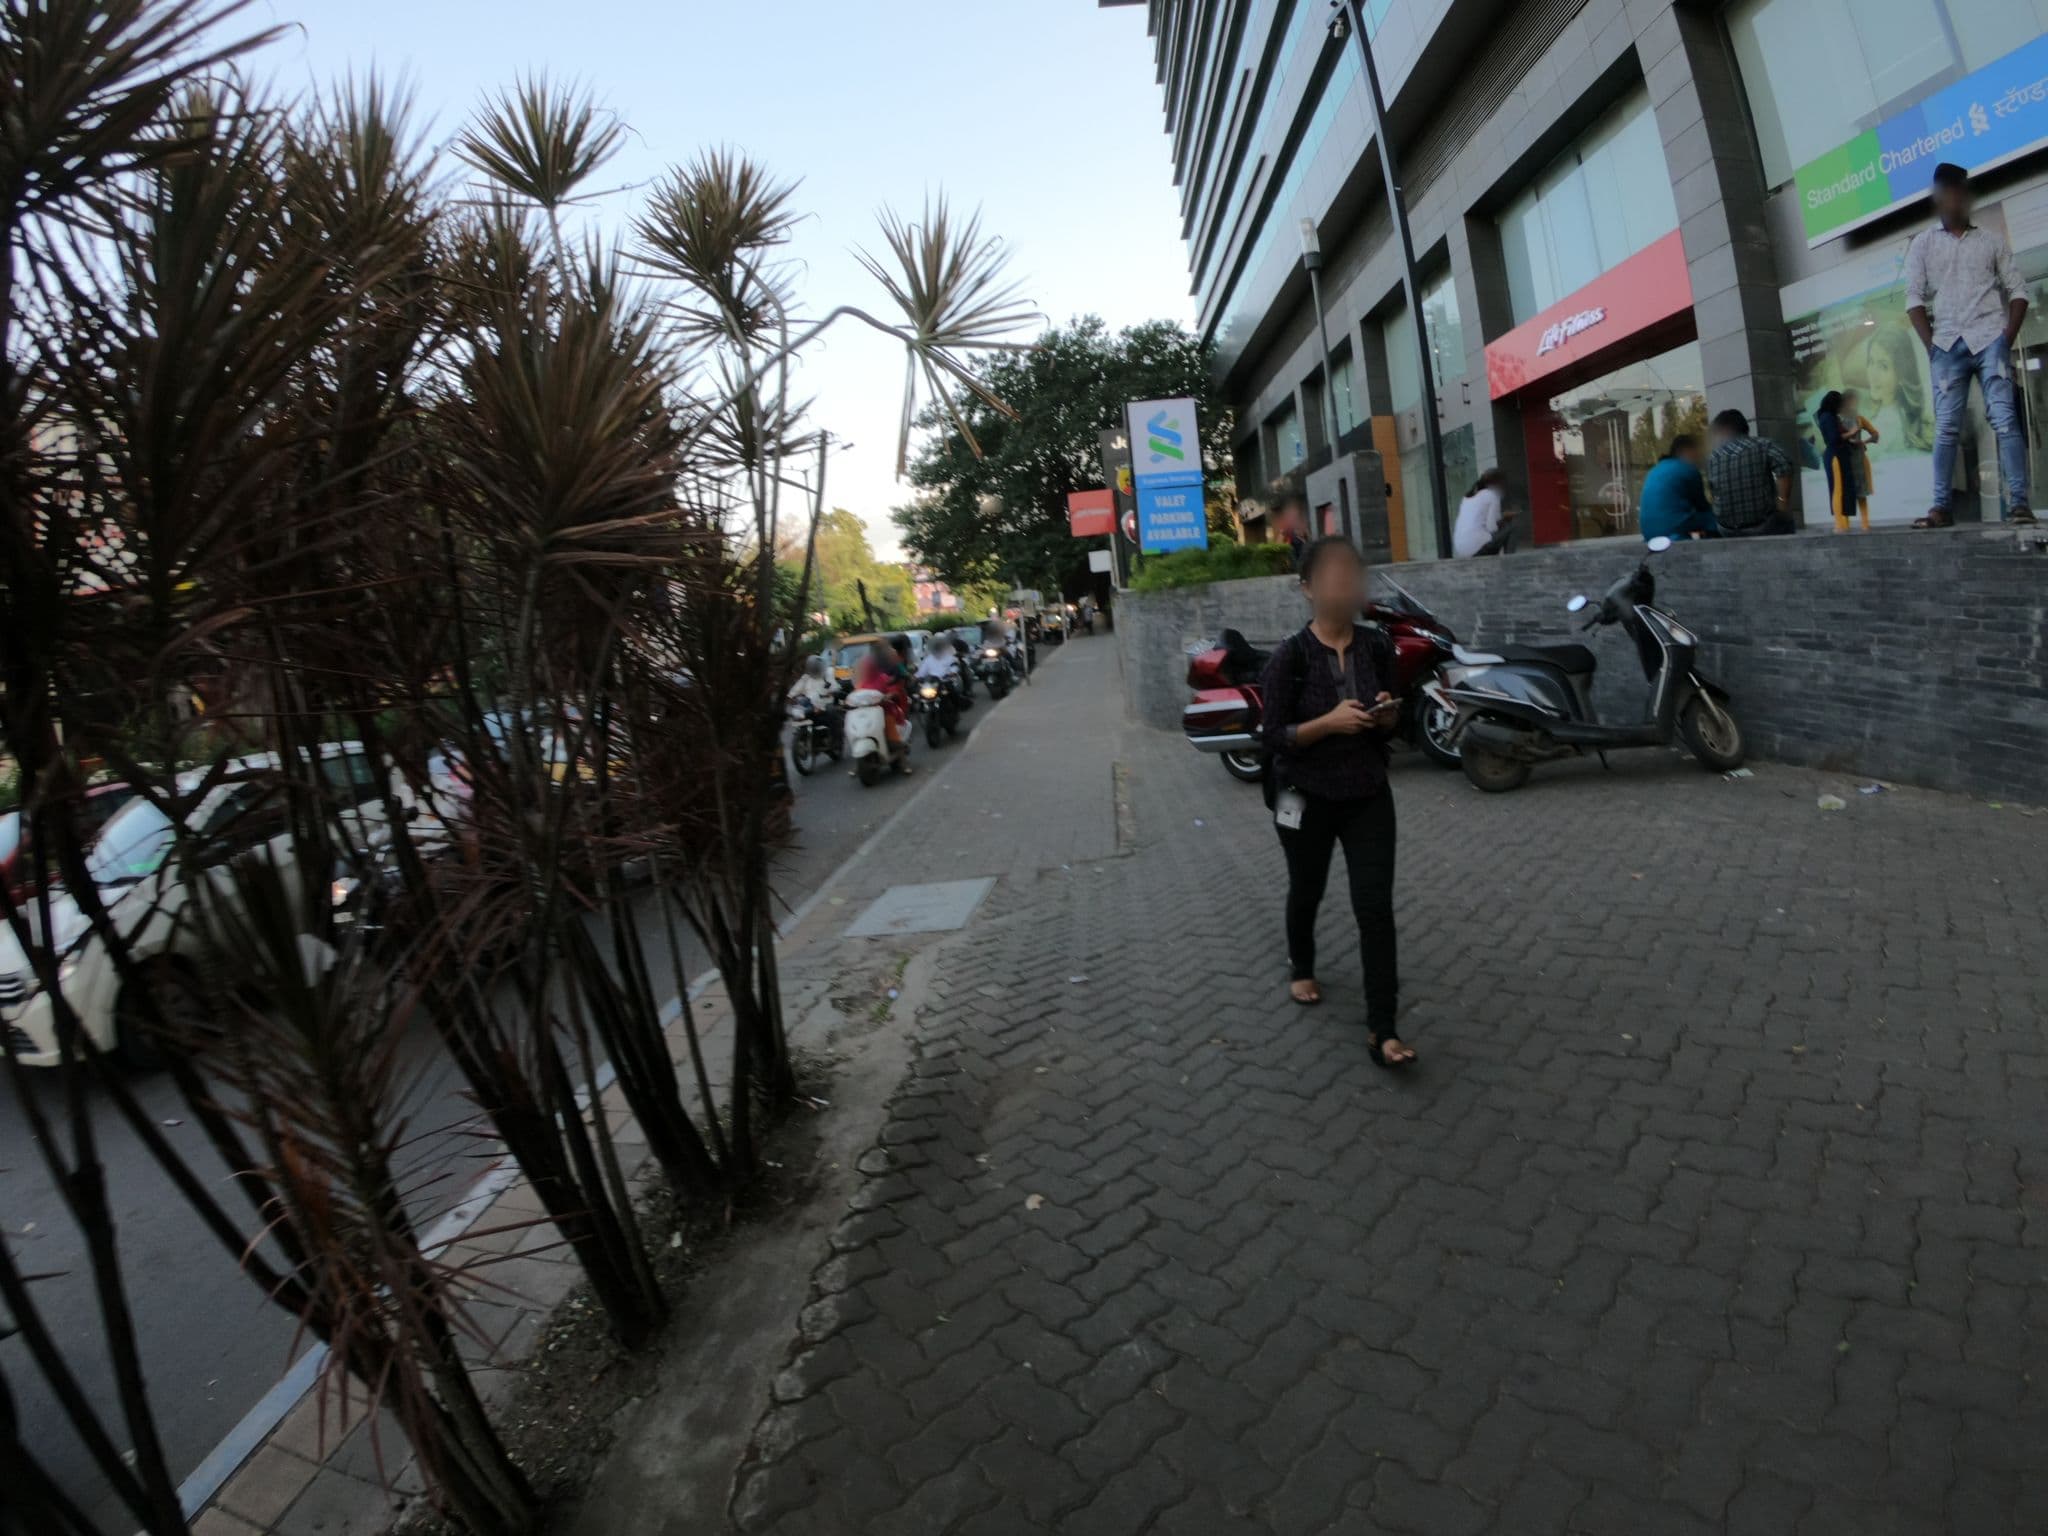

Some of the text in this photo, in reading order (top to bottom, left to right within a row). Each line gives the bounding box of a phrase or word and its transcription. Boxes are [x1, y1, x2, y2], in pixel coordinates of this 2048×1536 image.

[1807, 116, 1965, 209] Standard Chartered
[1536, 307, 1606, 356] Life Fitness
[1154, 494, 1186, 507] VALET
[1149, 512, 1195, 524] PARKING
[1147, 526, 1201, 541] AVAILABLE
